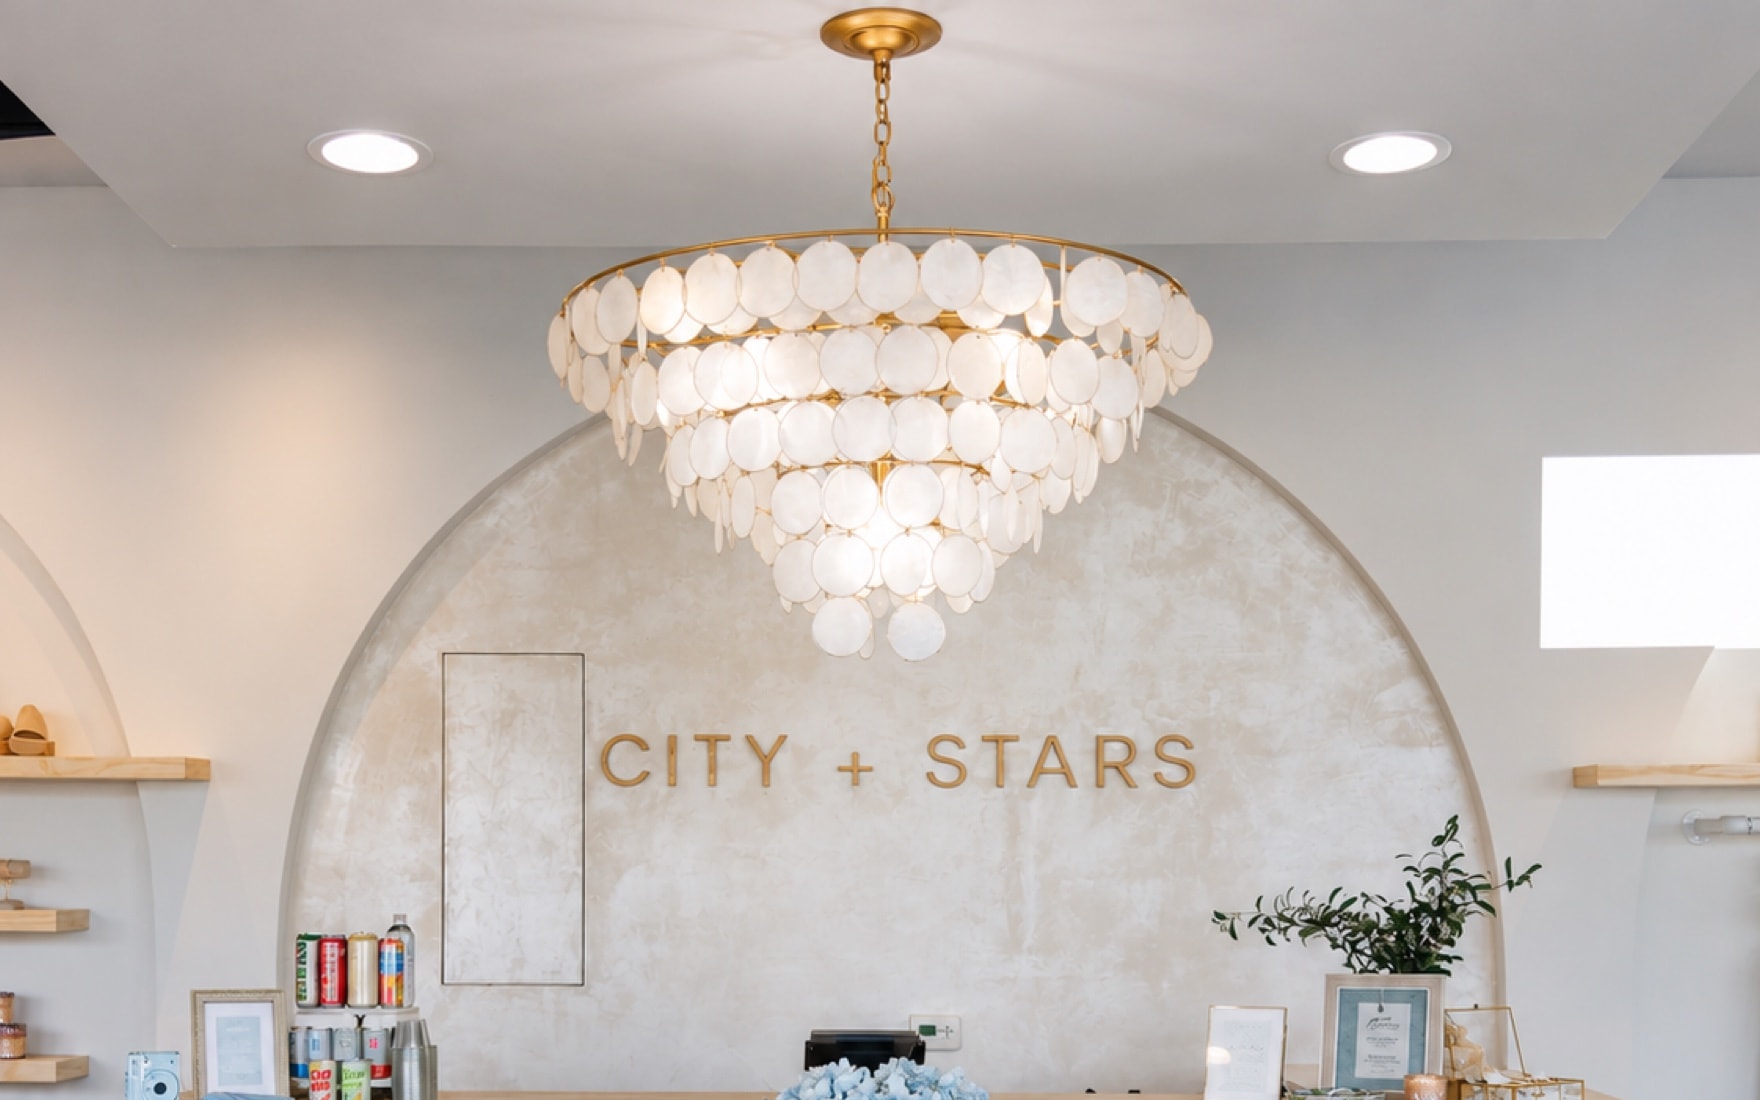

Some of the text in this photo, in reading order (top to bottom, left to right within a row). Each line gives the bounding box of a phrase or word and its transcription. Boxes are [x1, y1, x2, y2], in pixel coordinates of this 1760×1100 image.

[600, 734, 1196, 789] CITY + STARS
